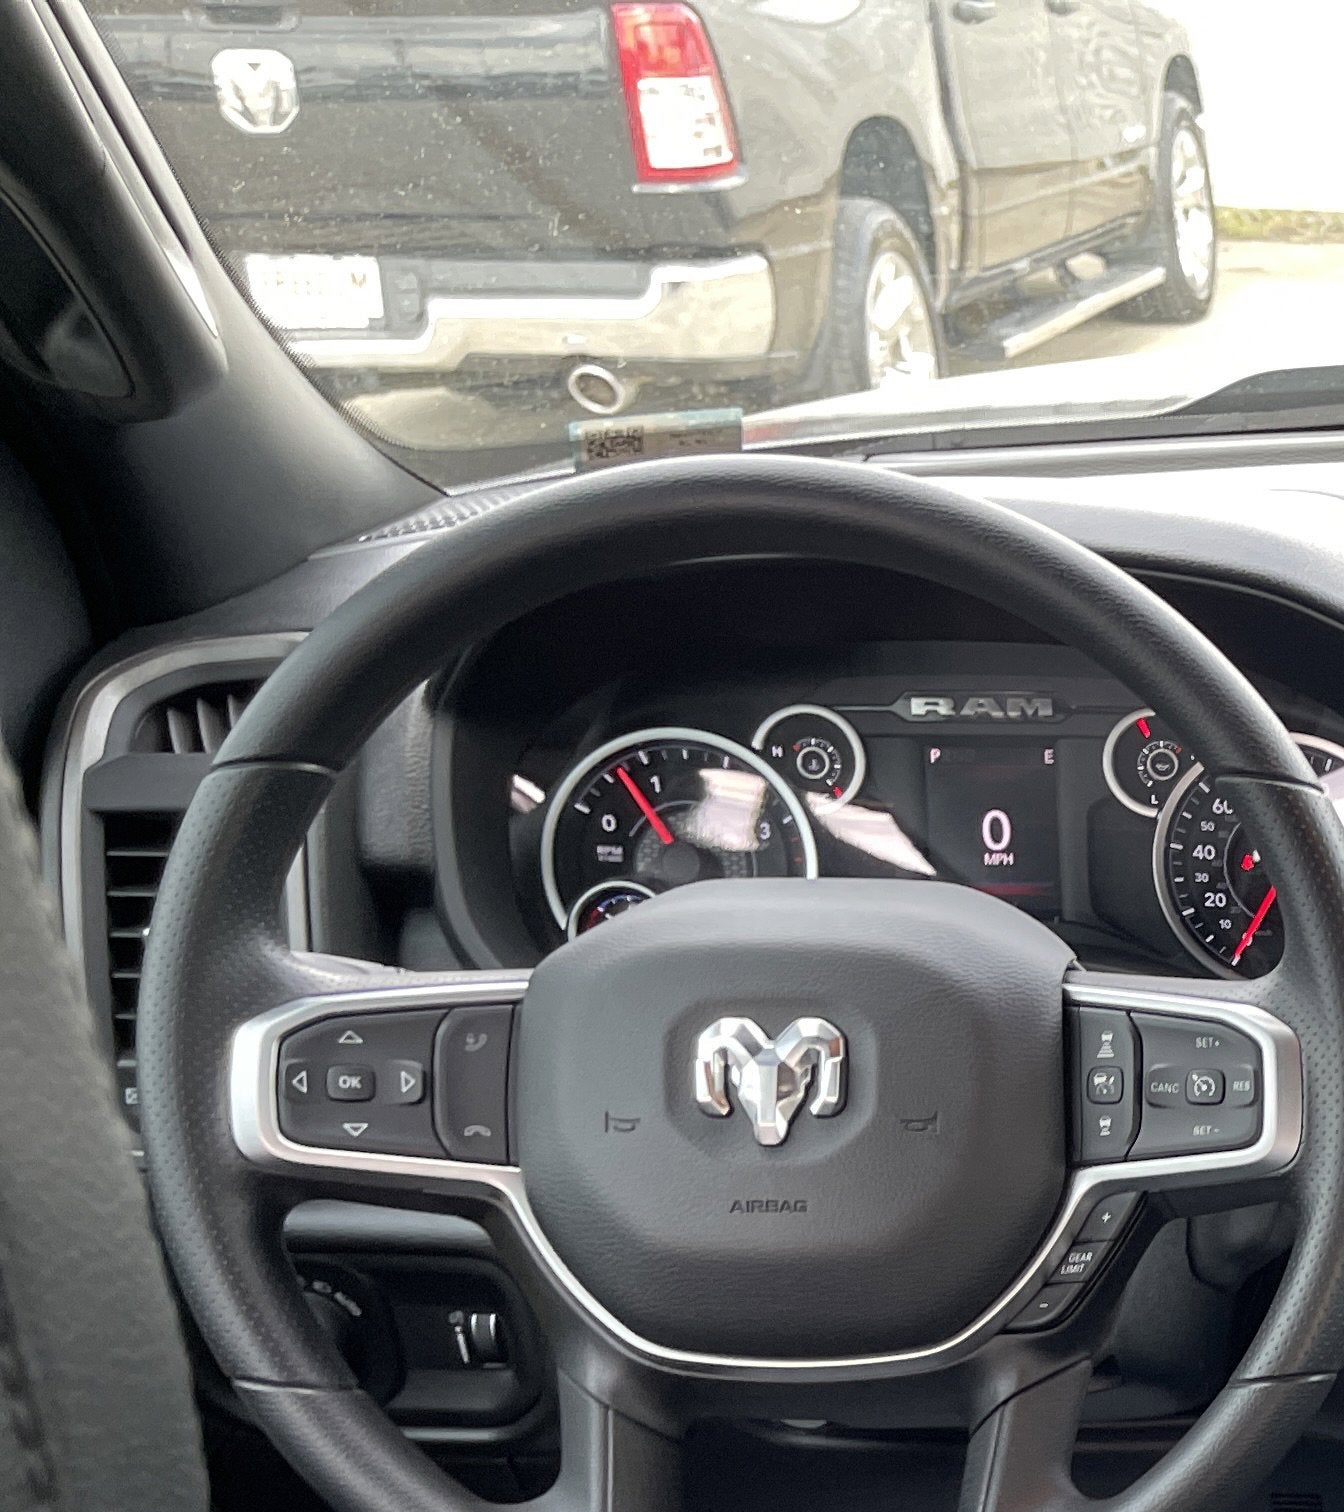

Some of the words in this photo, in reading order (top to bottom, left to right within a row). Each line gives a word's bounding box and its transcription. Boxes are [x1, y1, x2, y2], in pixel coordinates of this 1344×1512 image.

[910, 697, 1054, 716] RAM
[930, 748, 941, 764] P
[1044, 749, 1055, 764] E
[650, 775, 661, 793] 1
[601, 814, 618, 832] 0
[982, 809, 1012, 850] 0
[1200, 820, 1215, 833] 50
[760, 822, 771, 839] 3
[984, 852, 1014, 865] MPH
[1192, 845, 1216, 860] 40
[1194, 872, 1209, 883] 30
[1204, 892, 1226, 908] 20
[1219, 919, 1232, 929] 10
[338, 1075, 362, 1088] OK
[1150, 1082, 1180, 1093] CANC
[729, 1199, 808, 1213] AIRBAG
[1068, 1251, 1093, 1263] GEAR
[1060, 1263, 1085, 1275] LIMIT
